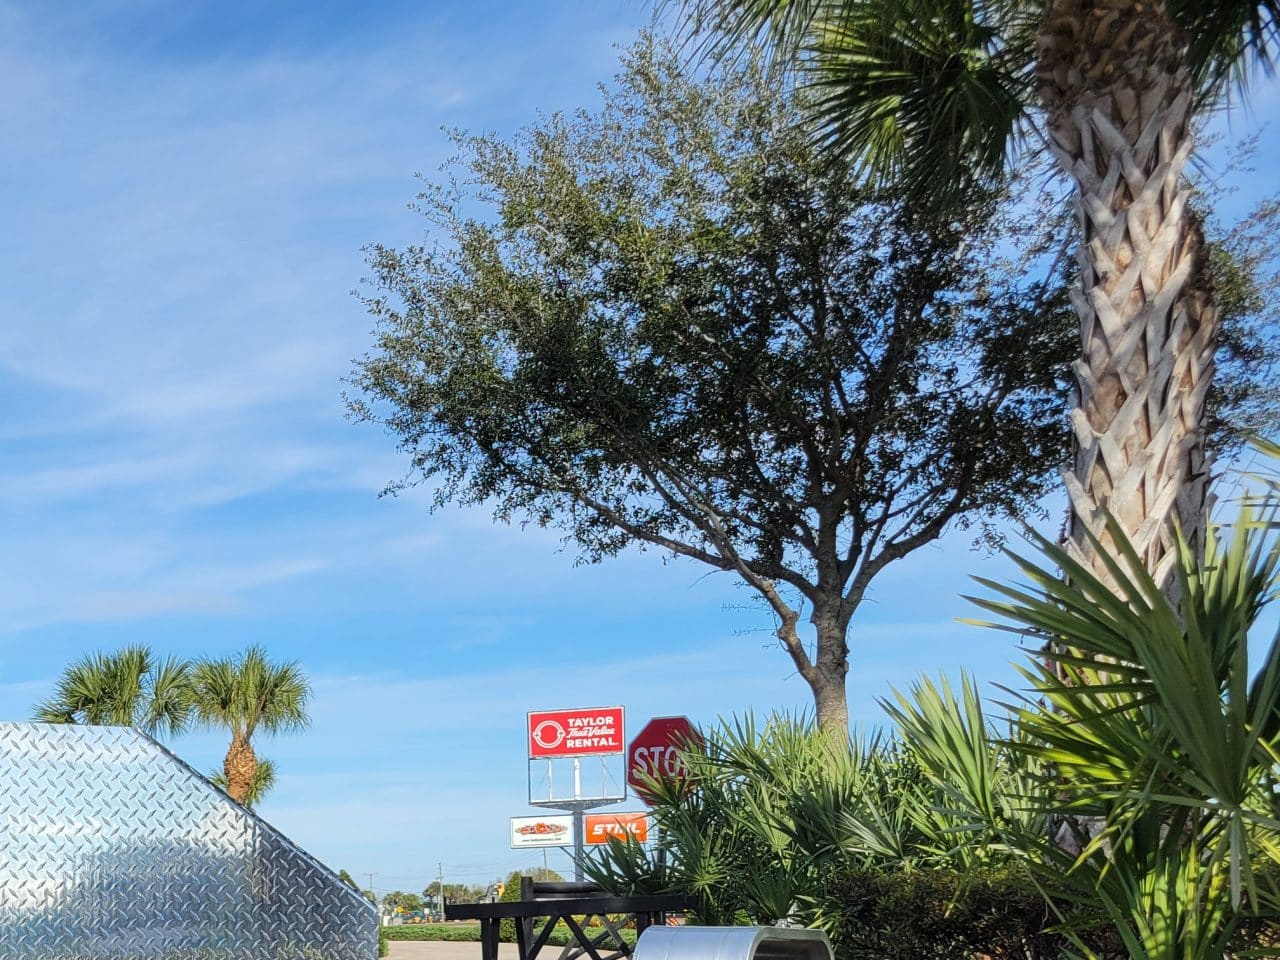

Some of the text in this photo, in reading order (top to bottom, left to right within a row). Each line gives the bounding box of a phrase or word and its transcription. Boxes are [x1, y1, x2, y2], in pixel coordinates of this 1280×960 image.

[567, 716, 614, 727] TAYLOR
[566, 737, 615, 748] RENTAL
[632, 745, 688, 779] STO
